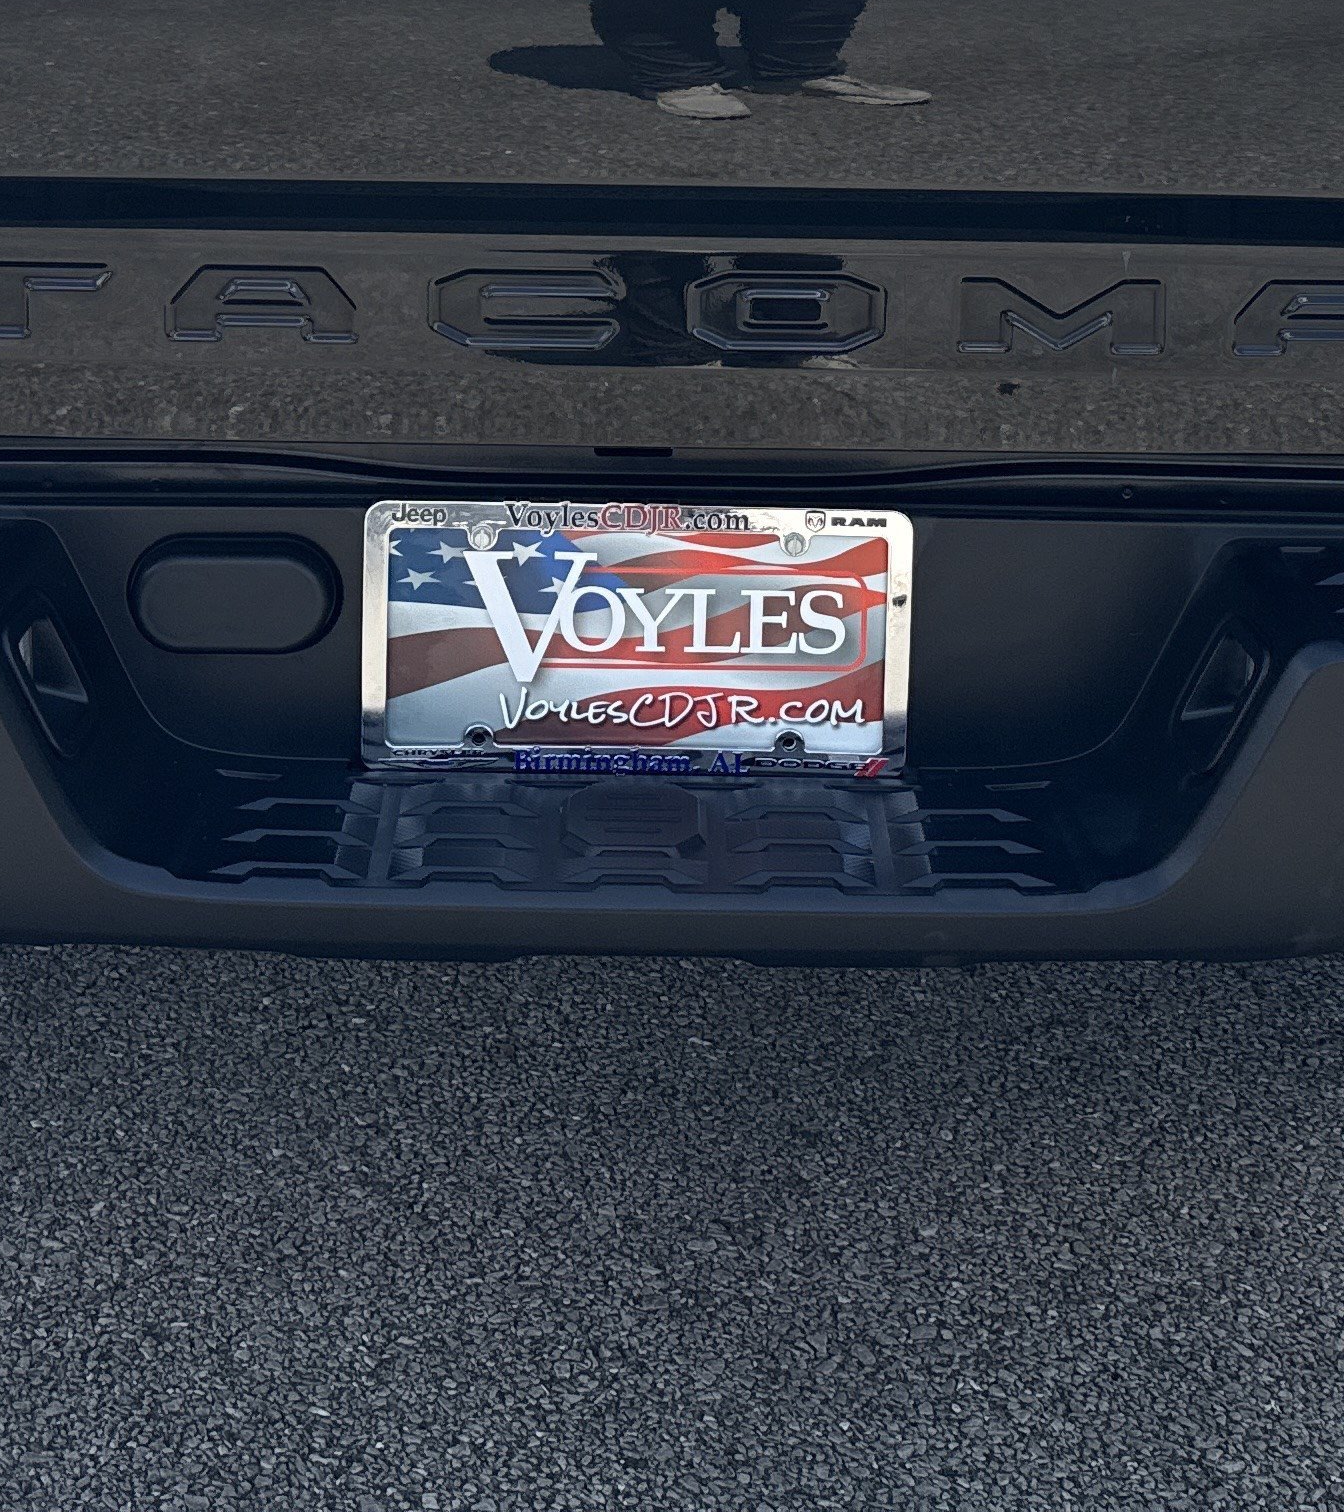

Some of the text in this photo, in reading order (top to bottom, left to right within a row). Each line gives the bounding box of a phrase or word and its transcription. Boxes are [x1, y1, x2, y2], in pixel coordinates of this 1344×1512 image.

[392, 502, 888, 535] Jeep VoylesCDJR.com RAM
[463, 550, 846, 683] VOYLES
[392, 748, 485, 756] CHRYSLER
[708, 749, 750, 775] AL
[755, 757, 867, 770] DODGE
